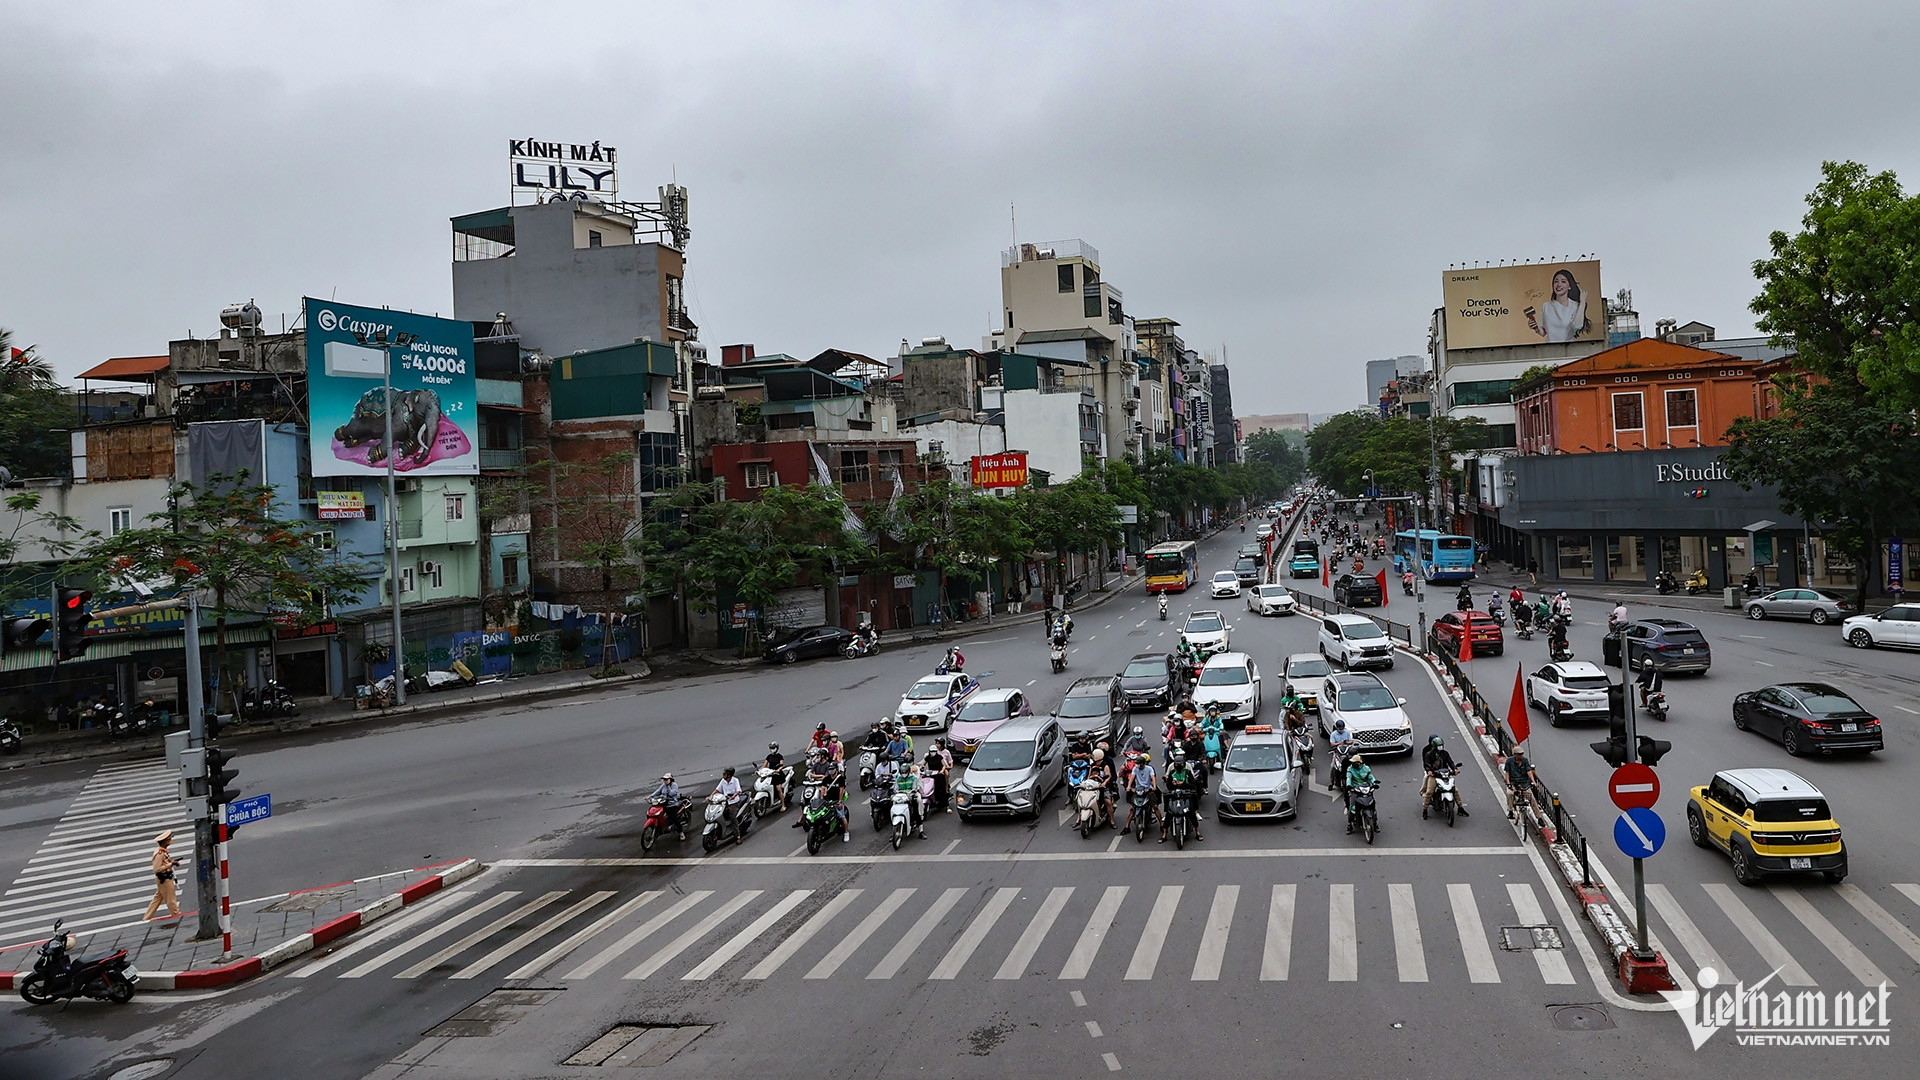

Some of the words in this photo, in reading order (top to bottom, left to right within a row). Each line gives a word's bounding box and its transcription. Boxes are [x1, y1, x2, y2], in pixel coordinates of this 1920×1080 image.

[511, 137, 563, 159] KÍNH
[570, 140, 616, 163] MẮT
[516, 163, 614, 191] LILY
[1466, 298, 1501, 308] Dream
[1459, 308, 1483, 318] Your
[1484, 306, 1509, 317] Style
[338, 315, 393, 338] Casper
[432, 345, 458, 356] NGON
[412, 354, 466, 374] 4.000đ
[980, 459, 999, 469] Hiệu
[1002, 457, 1019, 467] Ảnh
[974, 471, 998, 484] JUN
[1001, 469, 1025, 483] HUY
[482, 633, 504, 645] BÁN
[229, 809, 250, 823] CHÙA
[251, 805, 267, 818] BỘC
